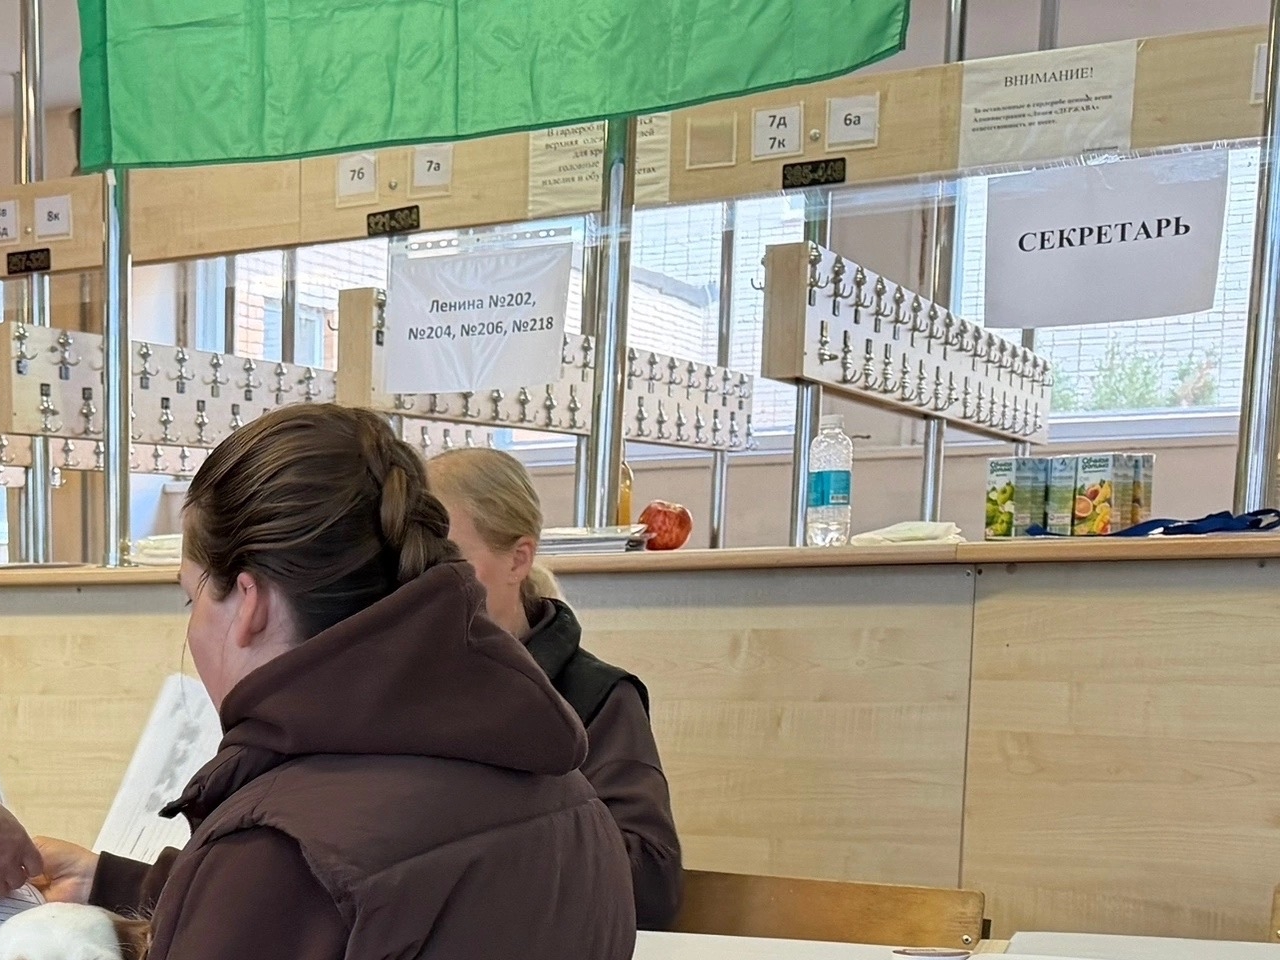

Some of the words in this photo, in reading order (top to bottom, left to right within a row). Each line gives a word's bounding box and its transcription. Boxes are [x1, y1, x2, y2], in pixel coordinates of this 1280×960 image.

[1004, 67, 1094, 87] ВНИМАНИЕ!
[768, 115, 787, 129] 7д
[843, 113, 861, 126] 6а
[769, 137, 786, 149] 7к
[426, 160, 441, 172] 7а
[350, 168, 365, 181] 7б
[47, 211, 60, 222] 8к
[1018, 216, 1191, 252] СЕКРЕТАРЬ
[429, 299, 484, 313] Ленина
[488, 292, 536, 308] №202,
[408, 325, 456, 340] №204,
[460, 320, 507, 337] №206,
[512, 316, 554, 333] №218
